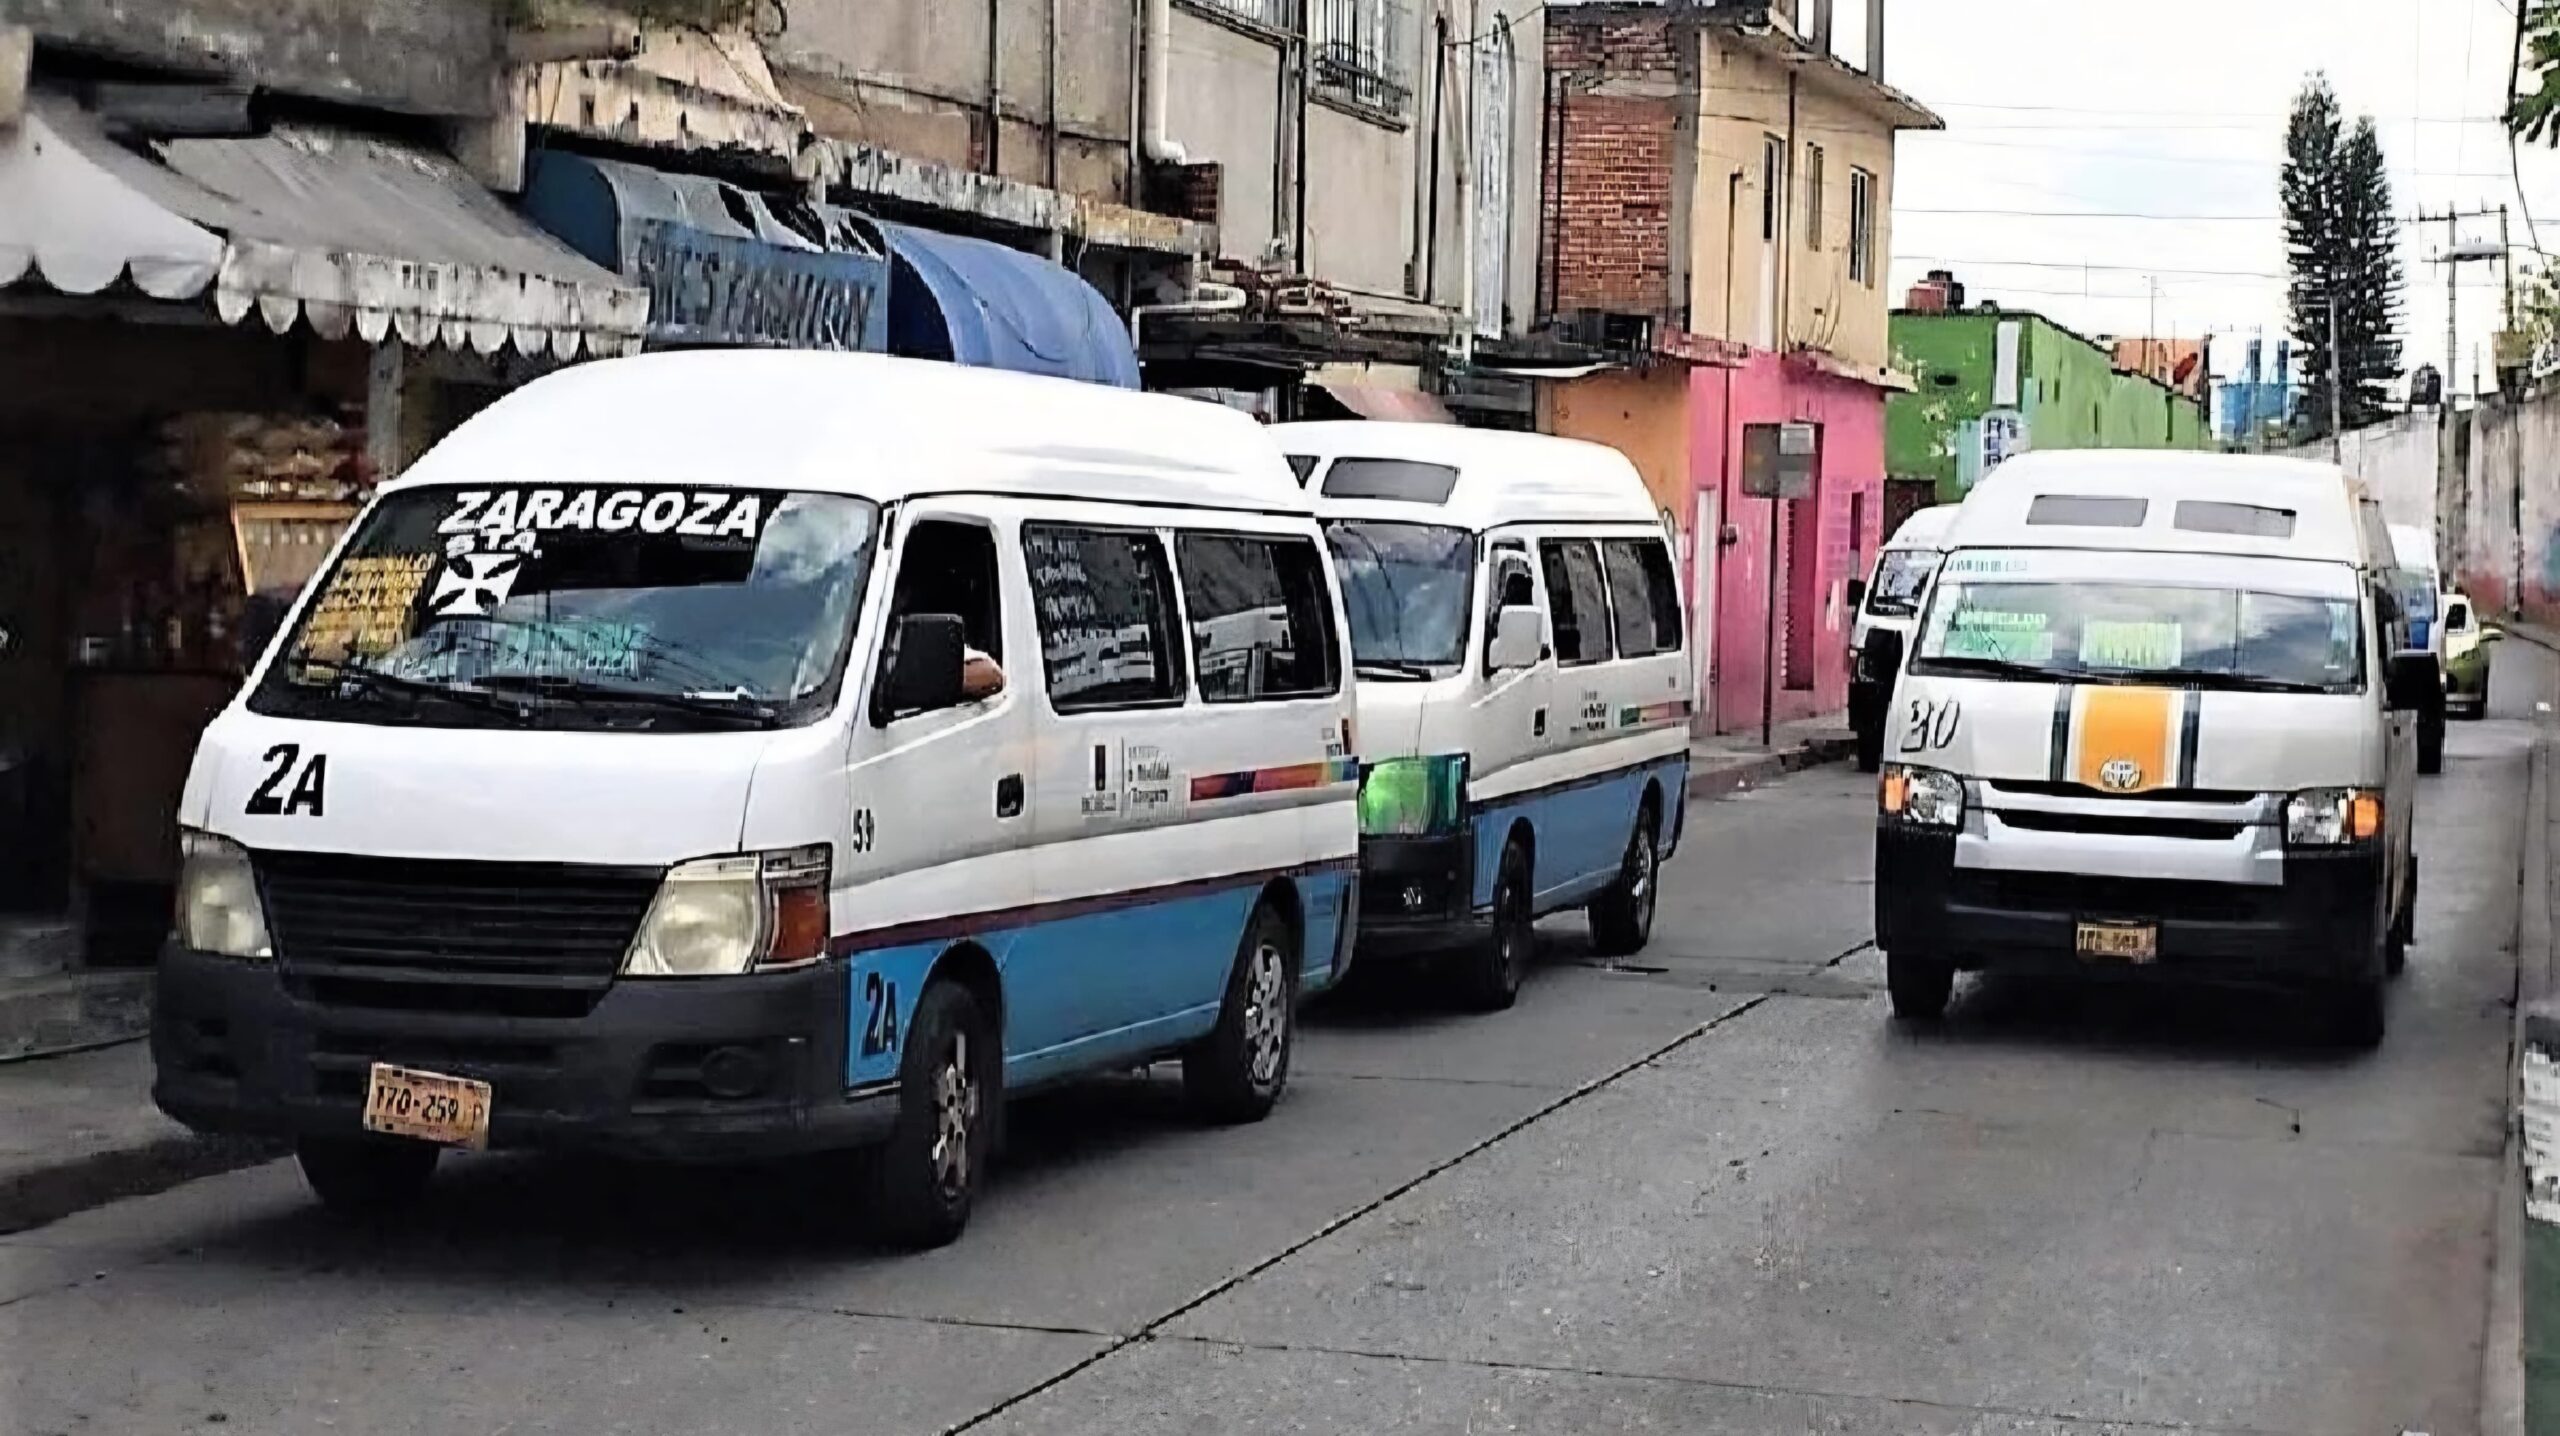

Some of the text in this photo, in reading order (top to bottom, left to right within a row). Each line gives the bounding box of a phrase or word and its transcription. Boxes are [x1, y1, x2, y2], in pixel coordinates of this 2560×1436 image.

[437, 489, 760, 538] ZARAGOZA
[244, 743, 327, 817] 2A
[862, 971, 897, 1056] 2A
